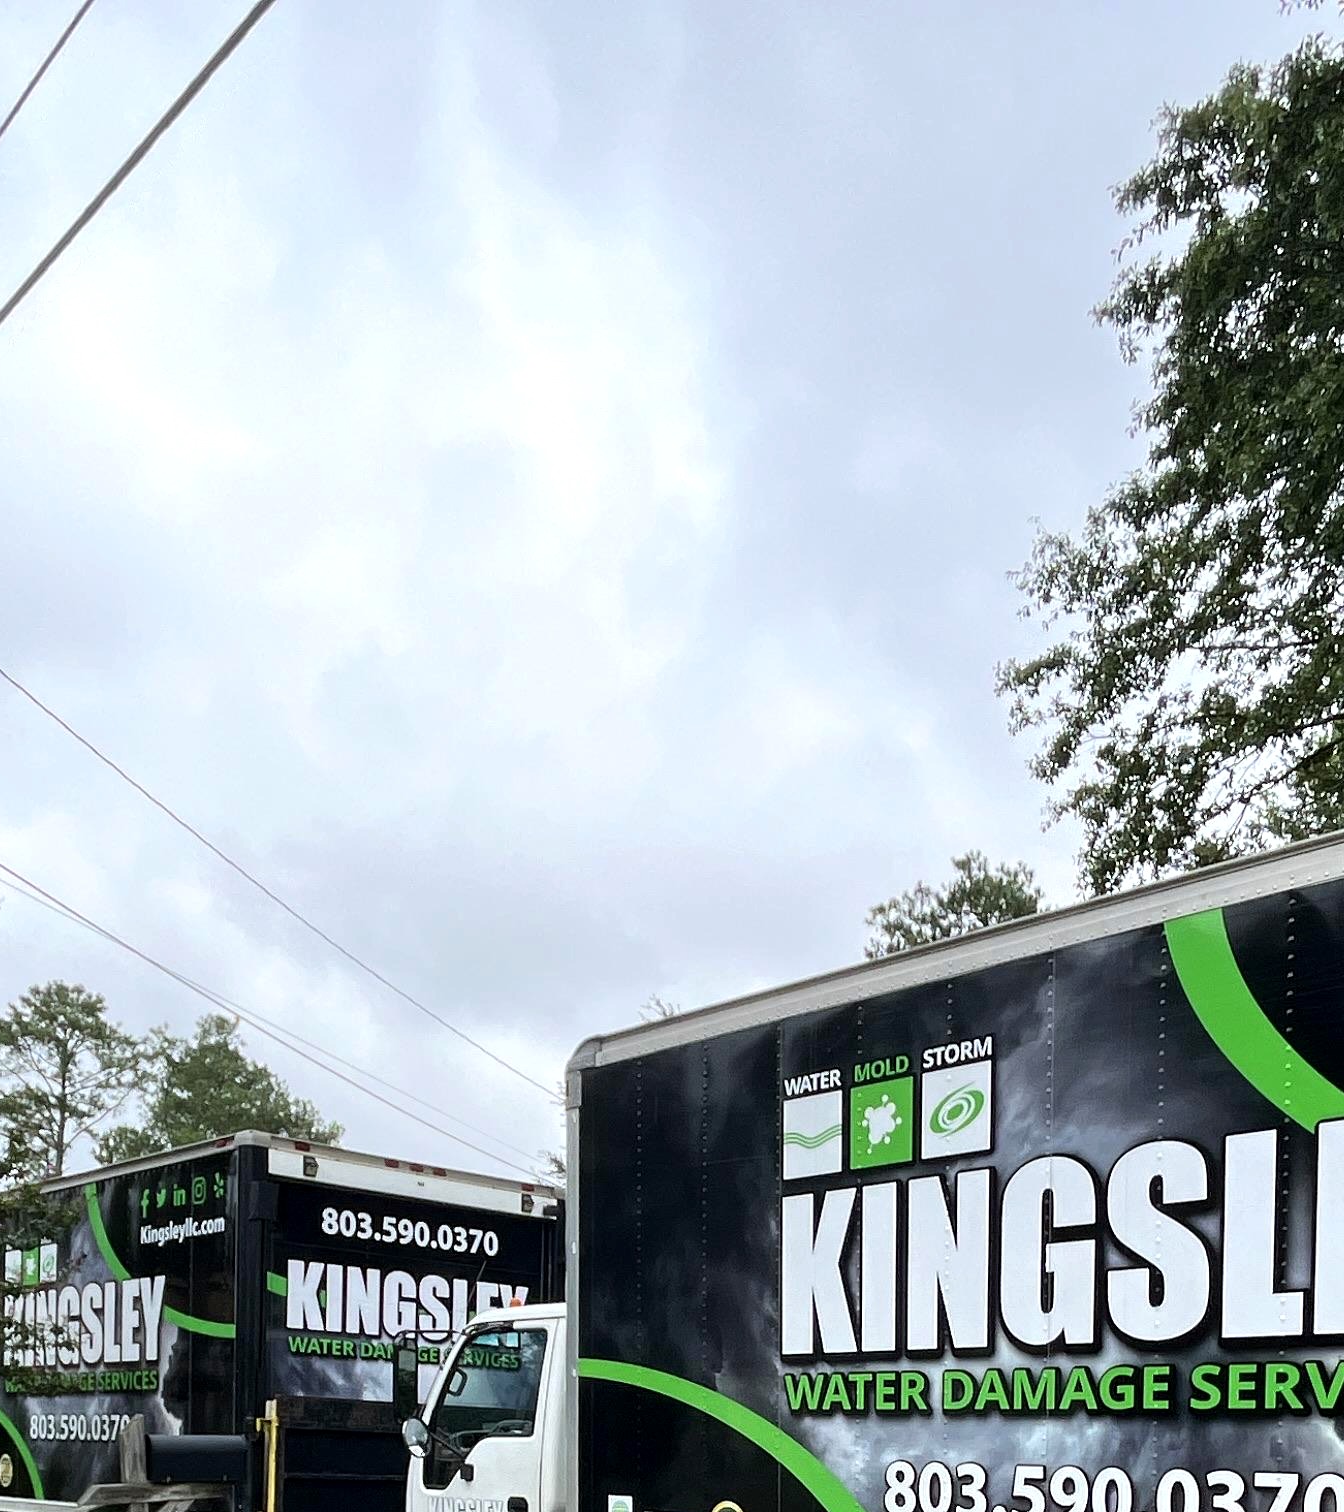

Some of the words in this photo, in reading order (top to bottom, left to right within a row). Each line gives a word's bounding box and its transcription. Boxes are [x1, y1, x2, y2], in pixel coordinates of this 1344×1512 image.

[784, 1069, 842, 1096] WATER
[854, 1056, 910, 1082] MOLD
[923, 1036, 993, 1068] STORM
[140, 1217, 226, 1247] Kingsleyllc.com
[321, 1207, 499, 1256] 803.590.0370
[288, 1336, 355, 1357] WATER
[360, 1342, 438, 1362] DAGE
[96, 1370, 158, 1391] SERVICES
[784, 1371, 927, 1411] WATER
[944, 1365, 1170, 1411] DAMAGE
